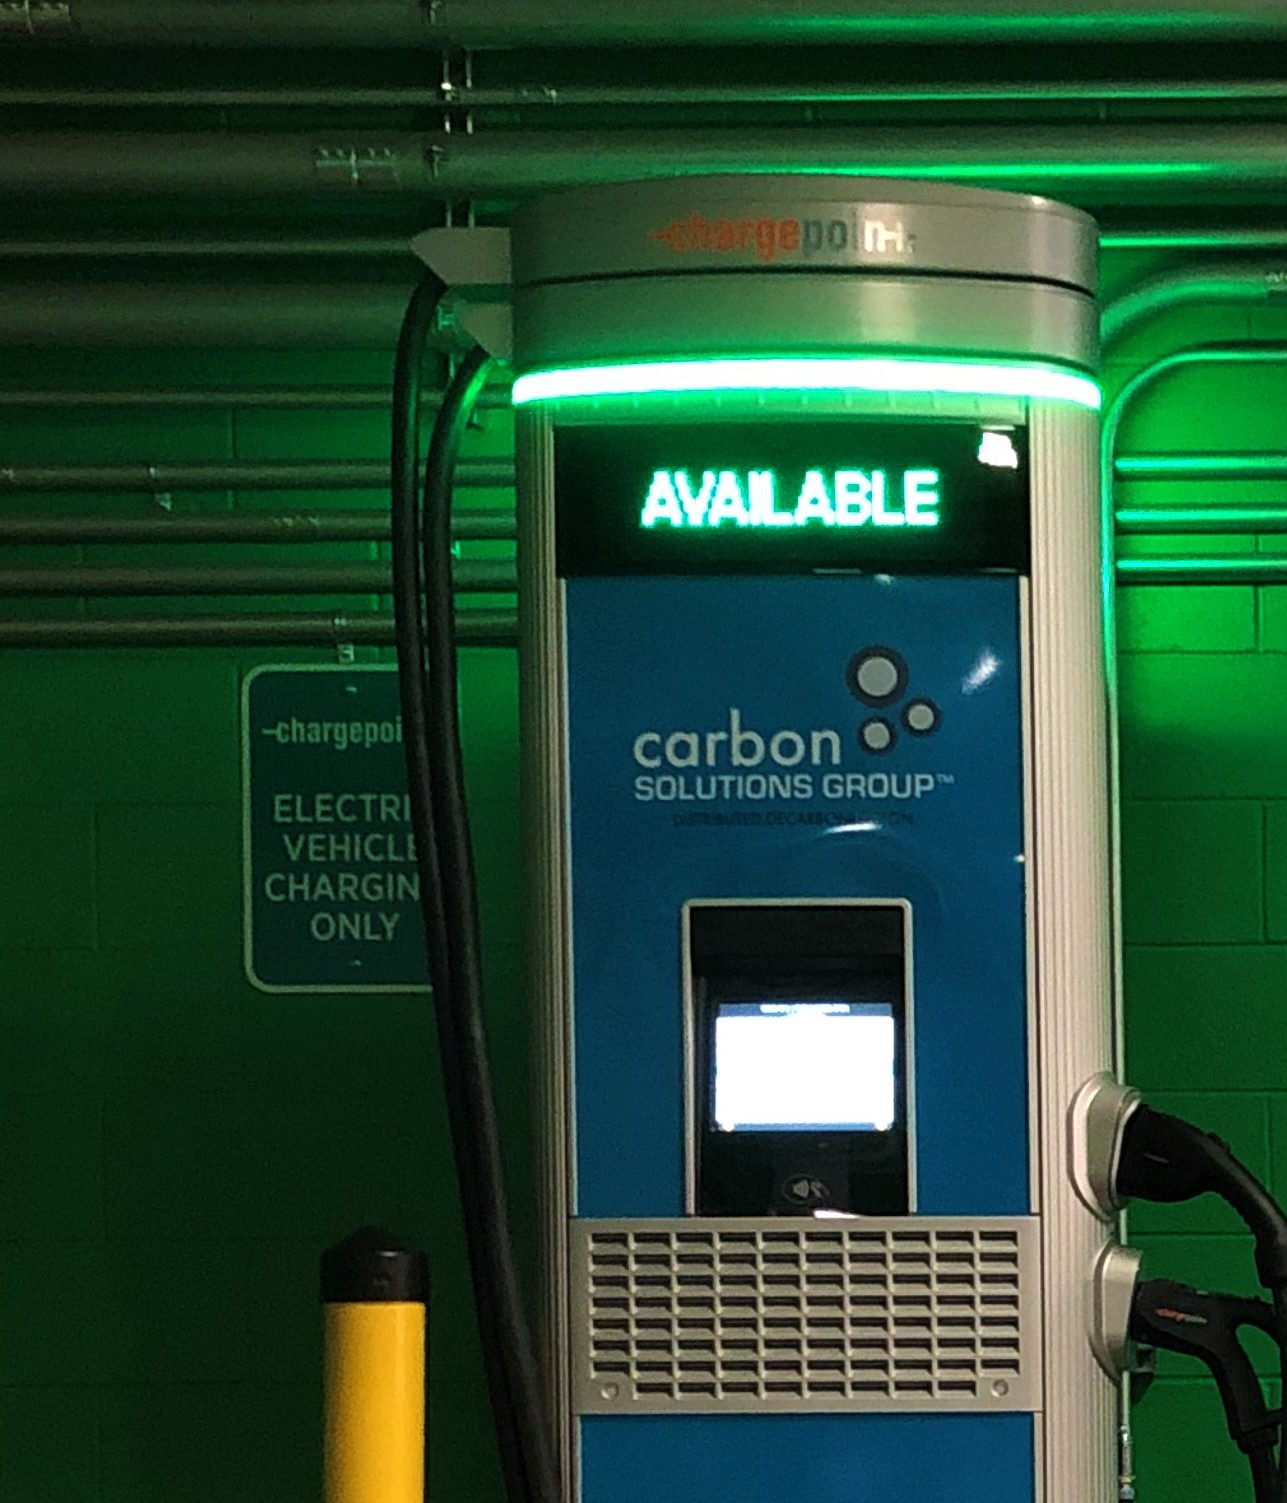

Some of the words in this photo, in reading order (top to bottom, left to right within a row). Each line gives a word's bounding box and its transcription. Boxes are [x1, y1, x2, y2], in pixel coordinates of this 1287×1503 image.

[640, 469, 942, 529] AVAILABLE
[262, 716, 402, 750] chargepoi
[632, 707, 842, 768] carbon
[634, 774, 813, 801] SOLUTIONS
[272, 793, 411, 824] ELECTRI
[264, 872, 421, 902] CHARGIN
[310, 911, 401, 942] ONLY
